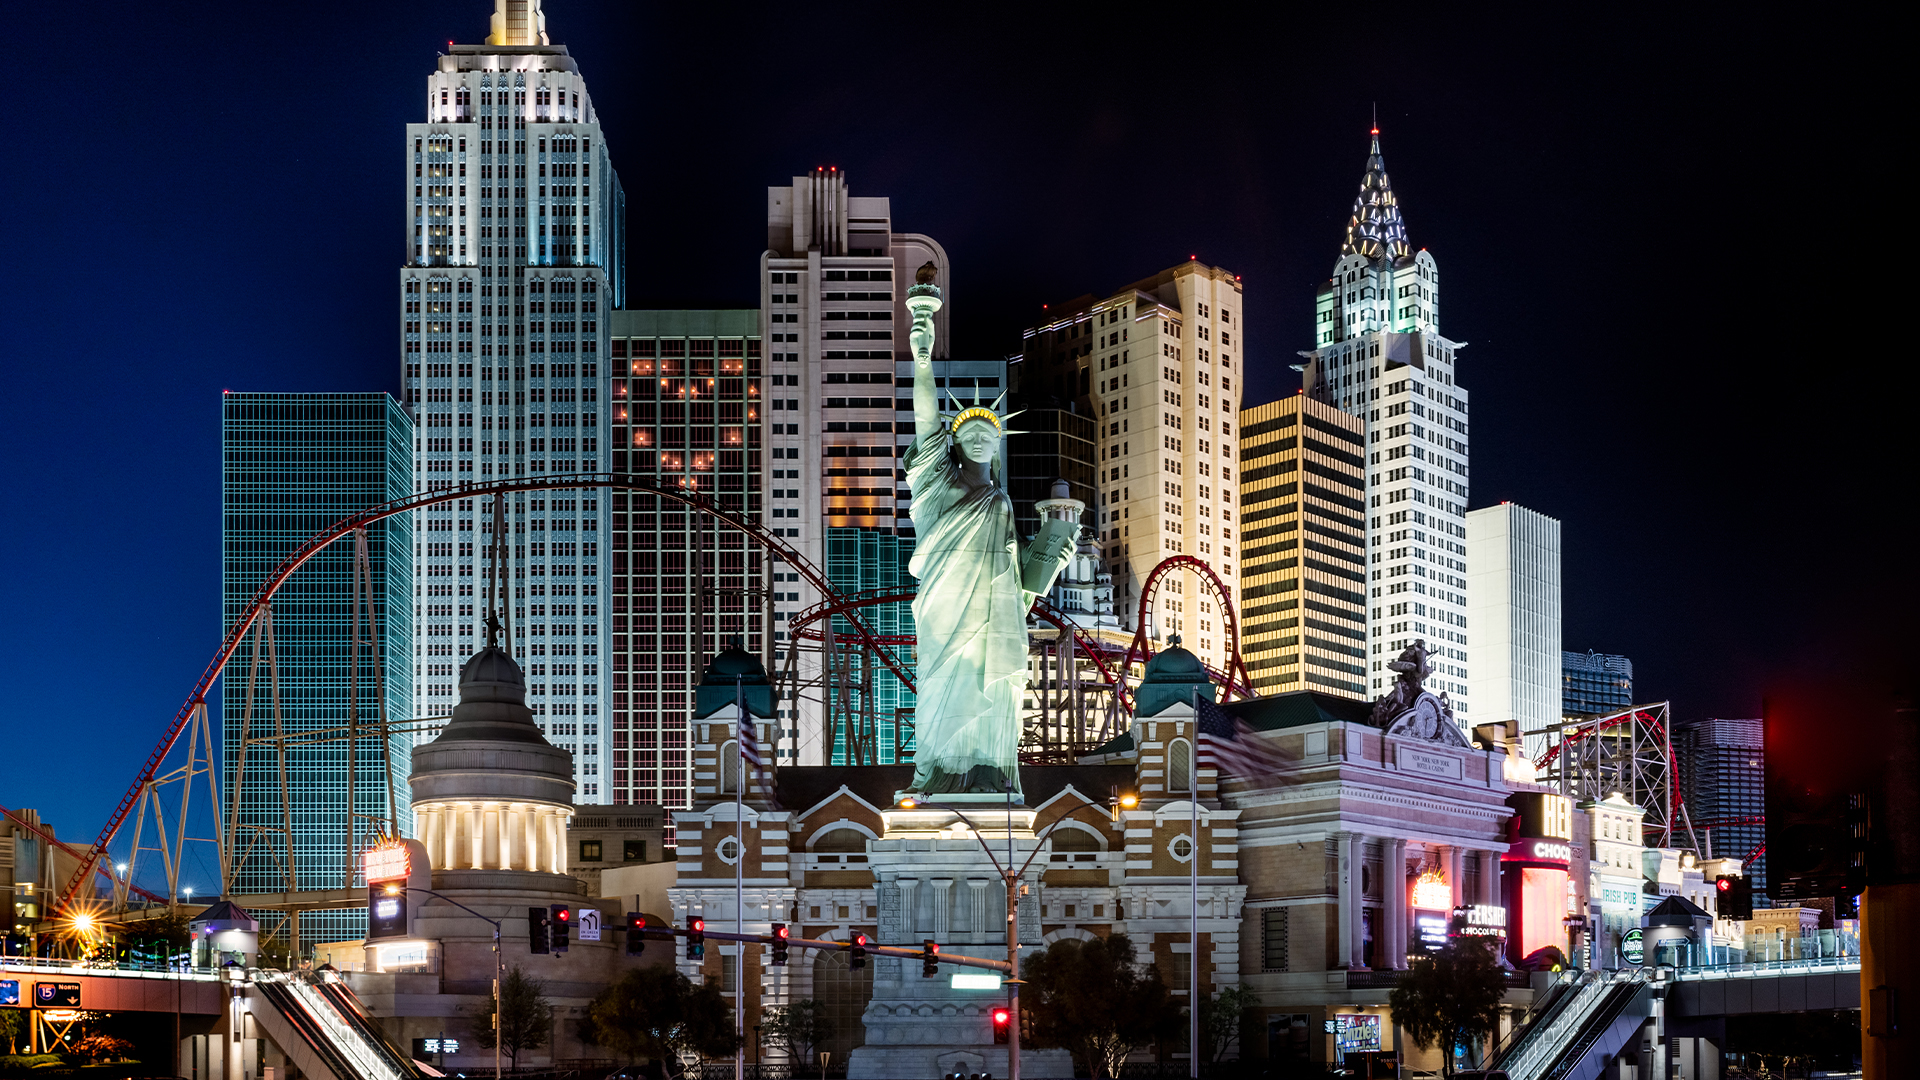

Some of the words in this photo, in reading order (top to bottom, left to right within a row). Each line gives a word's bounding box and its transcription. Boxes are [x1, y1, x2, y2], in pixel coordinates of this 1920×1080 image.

[1603, 889, 1621, 903] IRISH
[1623, 891, 1636, 904] PUB
[42, 987, 53, 998] 15
